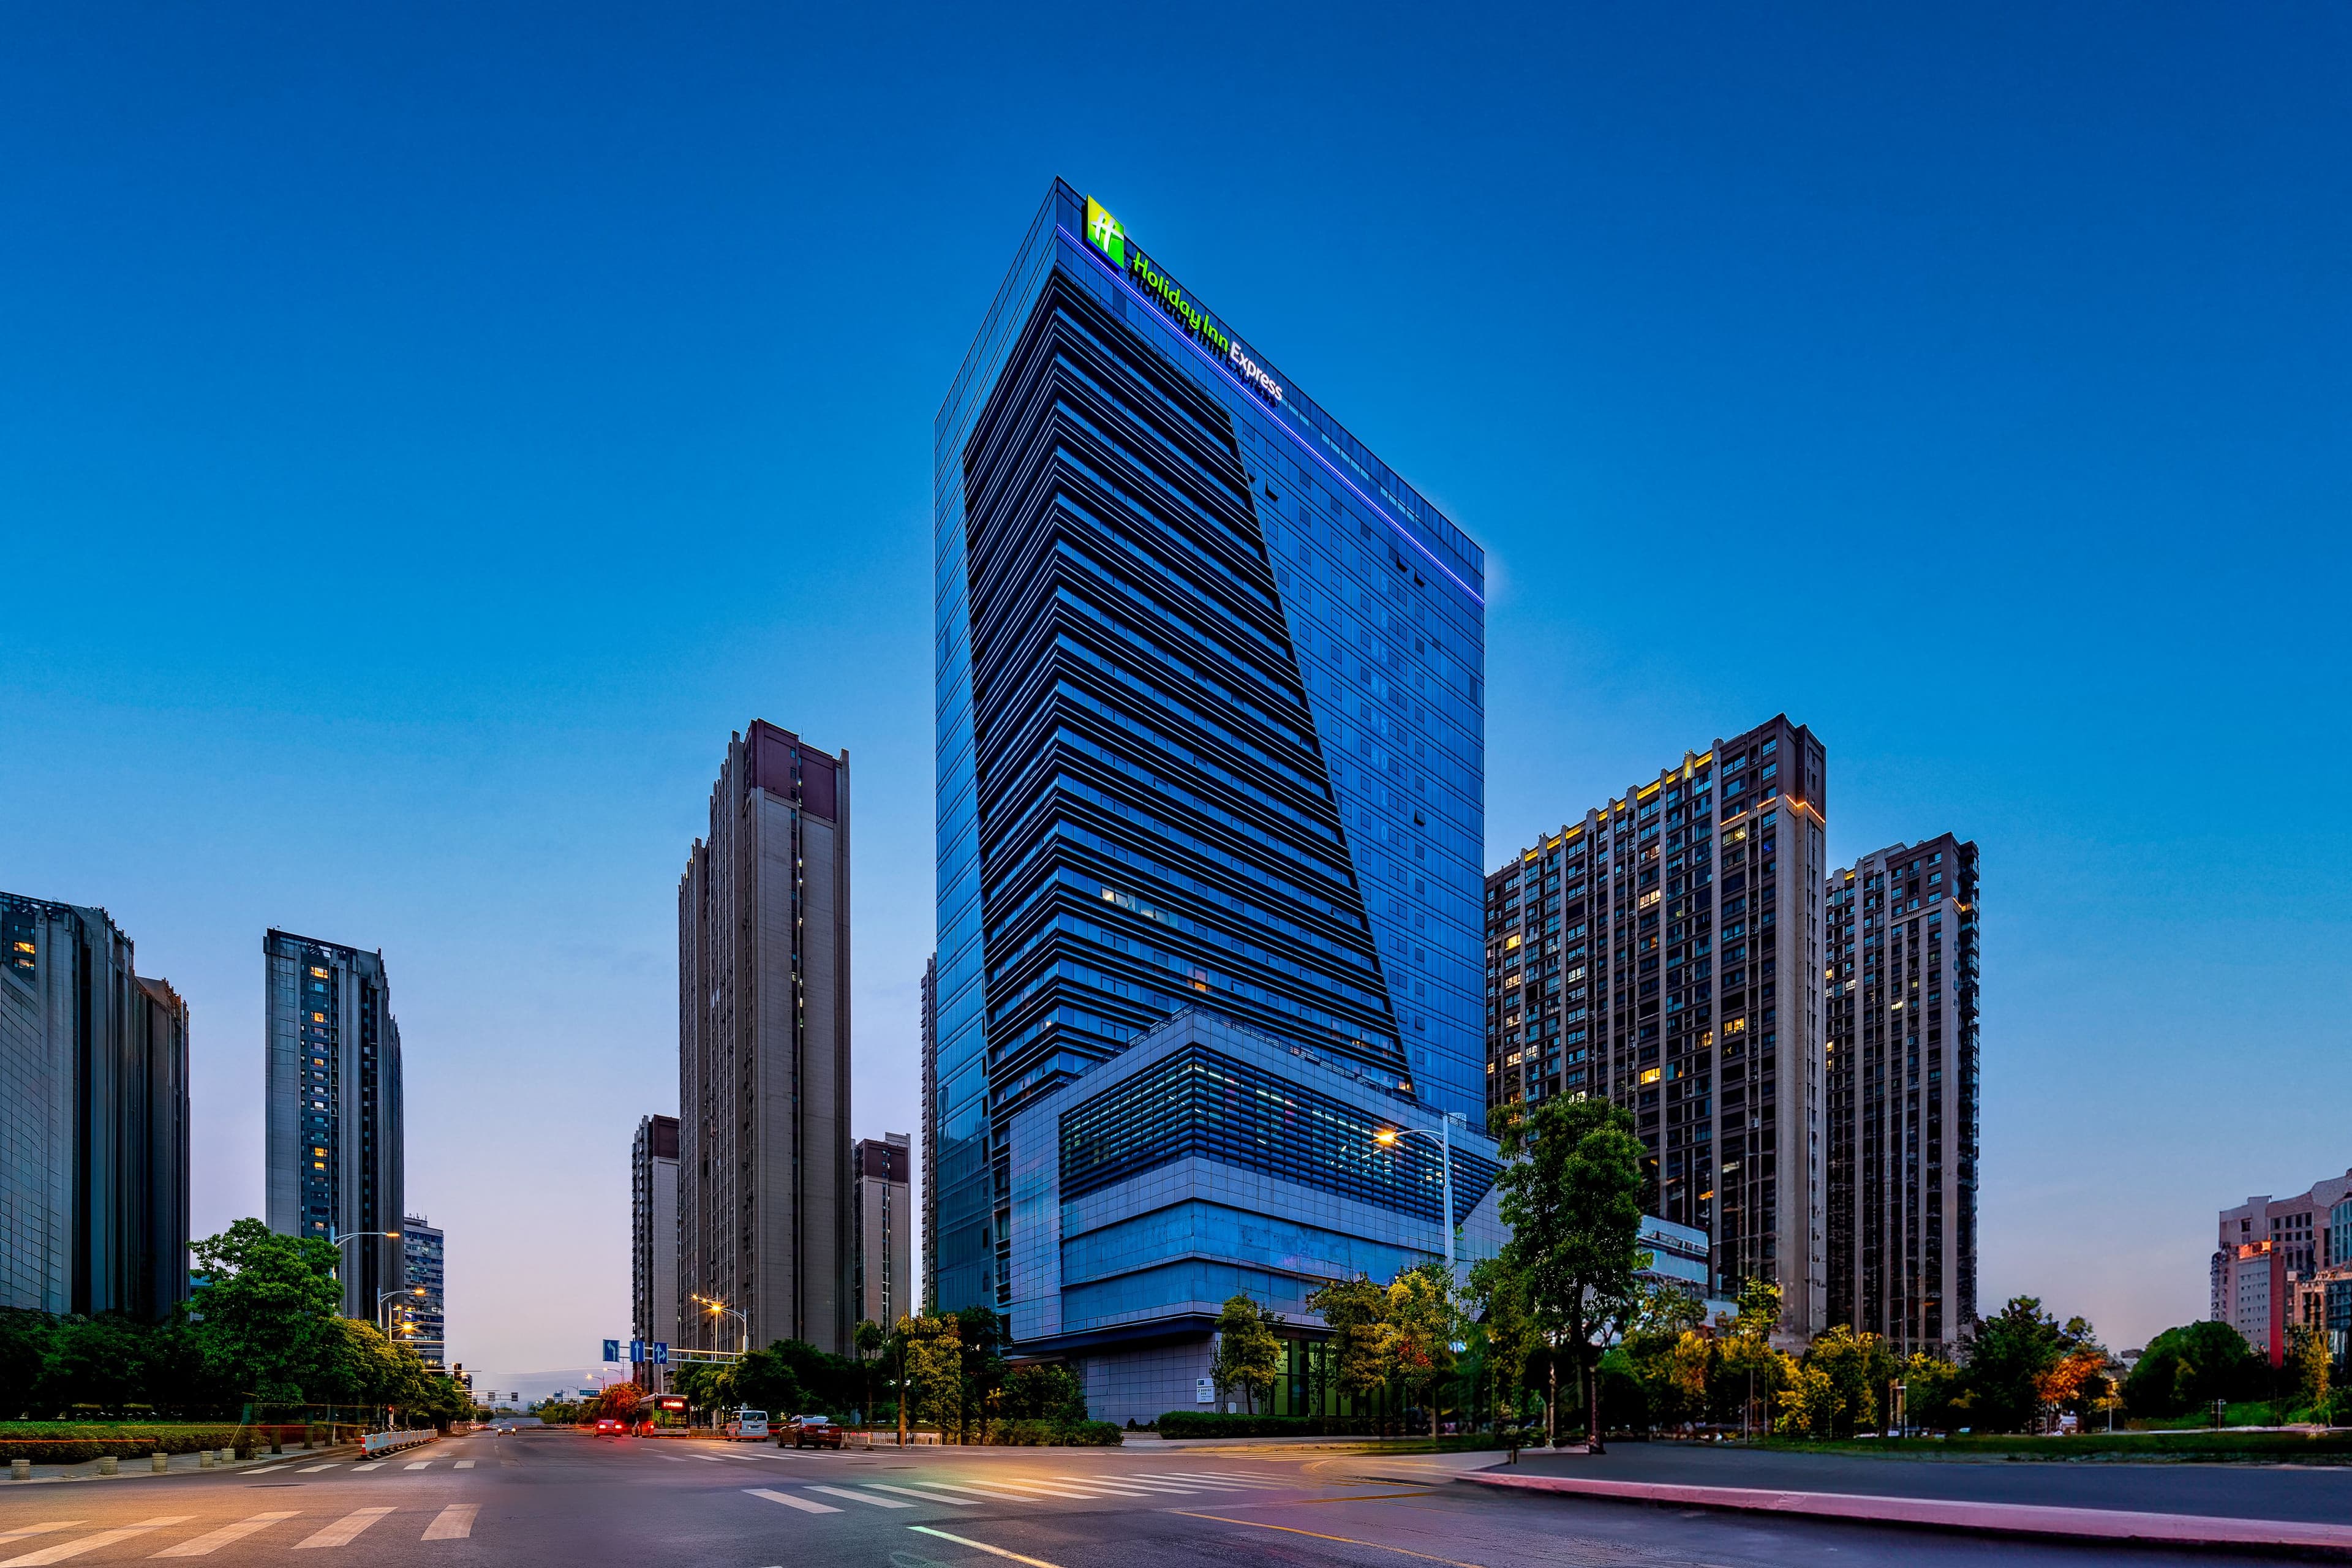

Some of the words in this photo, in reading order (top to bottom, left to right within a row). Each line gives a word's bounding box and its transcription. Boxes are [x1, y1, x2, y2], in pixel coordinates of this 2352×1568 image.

[1133, 251, 1200, 330] Holiday
[1203, 314, 1229, 353] Inn
[1230, 341, 1283, 401] Express
